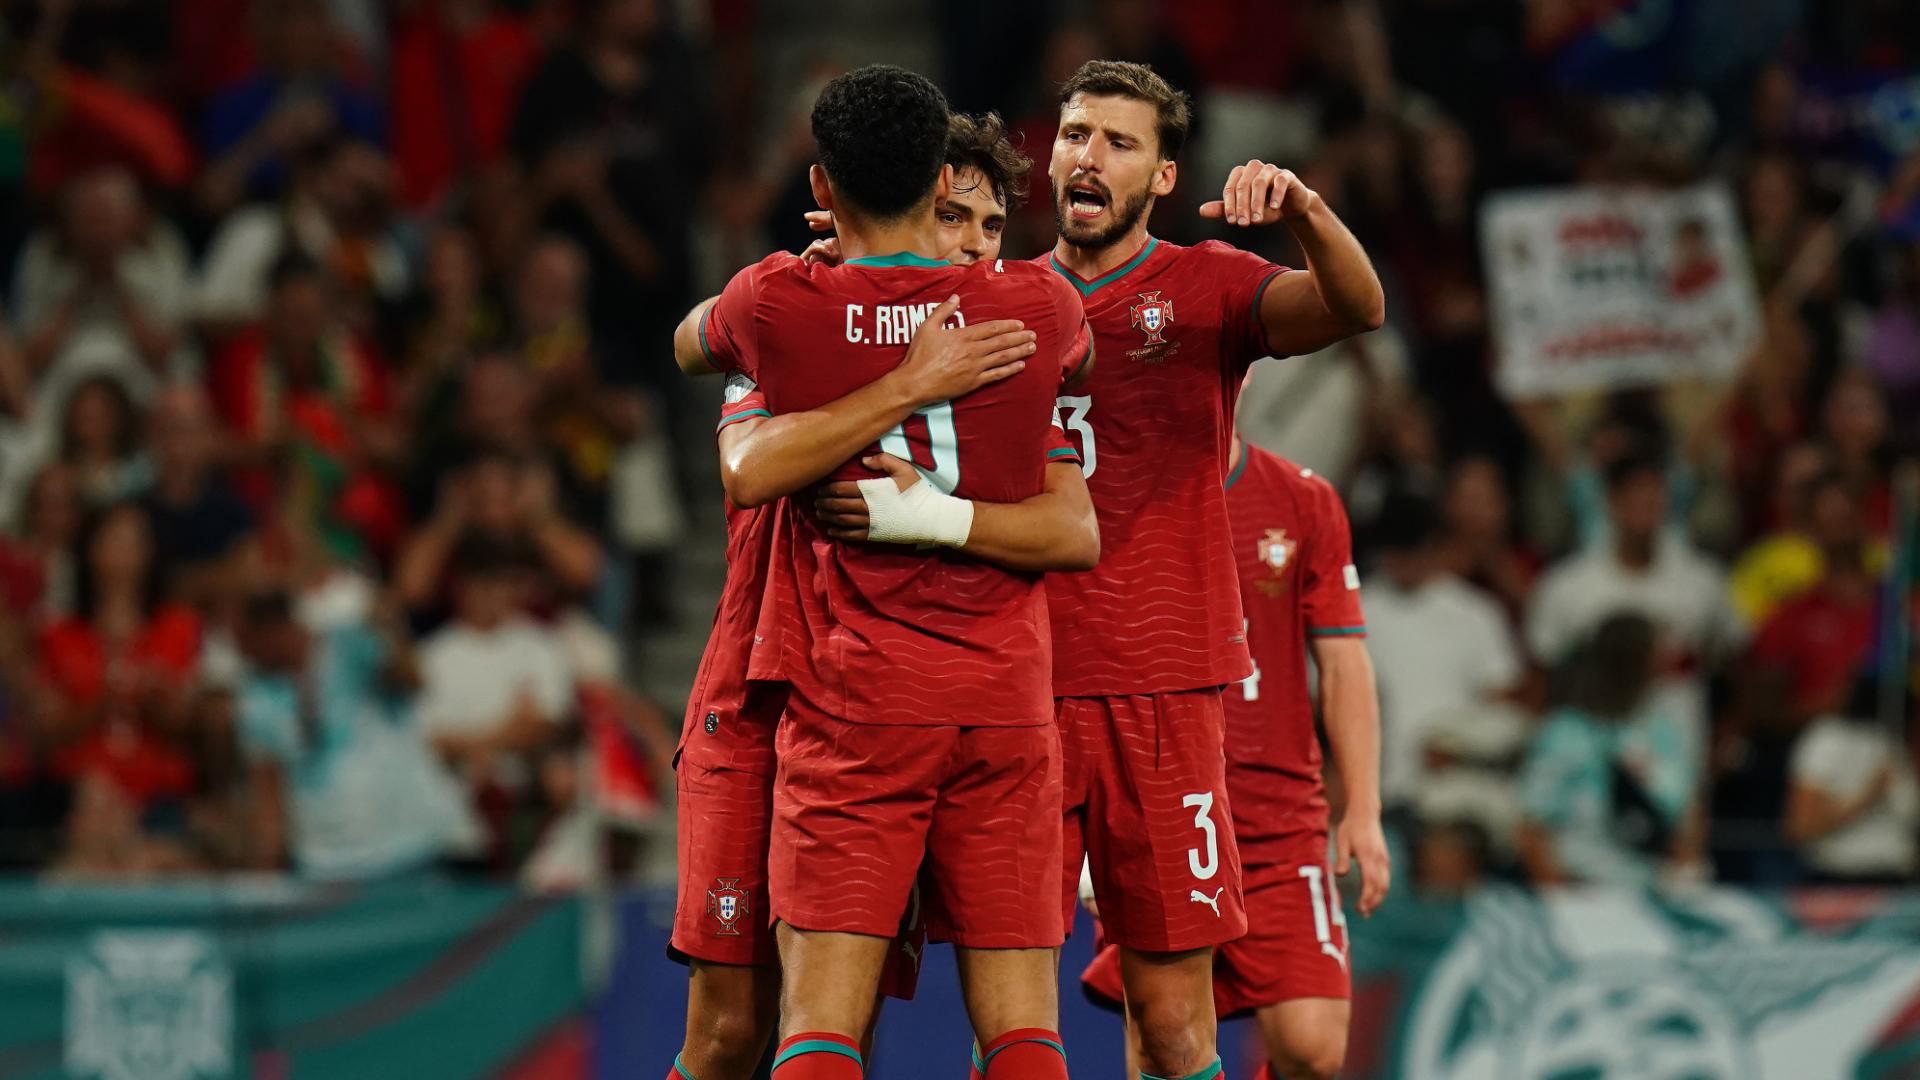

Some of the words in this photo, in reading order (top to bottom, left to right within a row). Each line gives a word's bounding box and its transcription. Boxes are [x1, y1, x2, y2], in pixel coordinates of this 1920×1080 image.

[846, 304, 870, 344] G.
[1056, 394, 1097, 480] 3
[1182, 791, 1219, 880] 3
